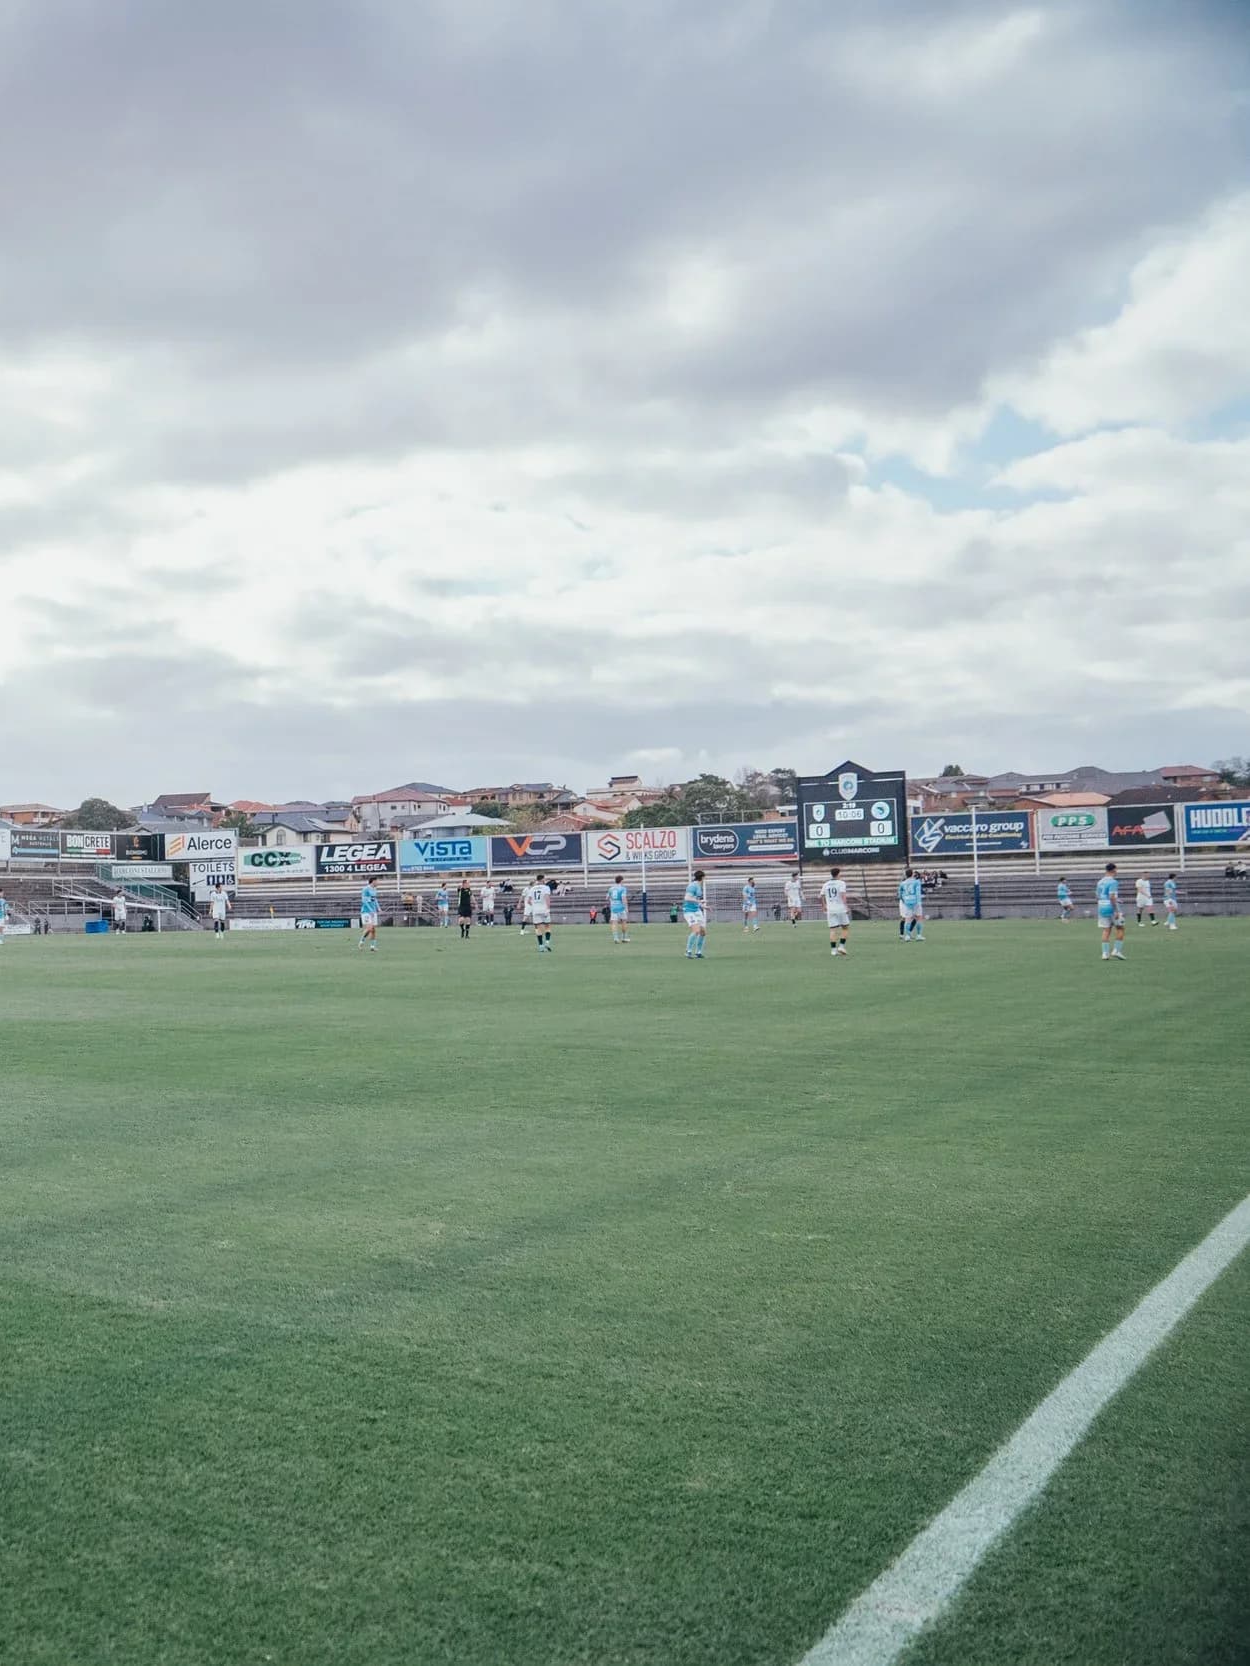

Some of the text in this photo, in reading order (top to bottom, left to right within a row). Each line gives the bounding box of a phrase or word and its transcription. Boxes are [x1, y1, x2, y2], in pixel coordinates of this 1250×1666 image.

[1057, 815, 1087, 826] PPS
[815, 826, 823, 837] 0
[877, 822, 885, 834] 0
[989, 821, 1024, 833] group
[187, 837, 232, 850] Alerce
[625, 831, 676, 849] SCALZO
[700, 834, 735, 846] brydens
[505, 835, 567, 857] VCP
[713, 843, 735, 851] lawyers
[320, 844, 392, 862] LEGEA
[654, 850, 676, 859] GROUP
[192, 863, 235, 873] TOILETS
[355, 864, 387, 872] LEGEA
[534, 890, 542, 900] 17
[828, 887, 838, 898] 19
